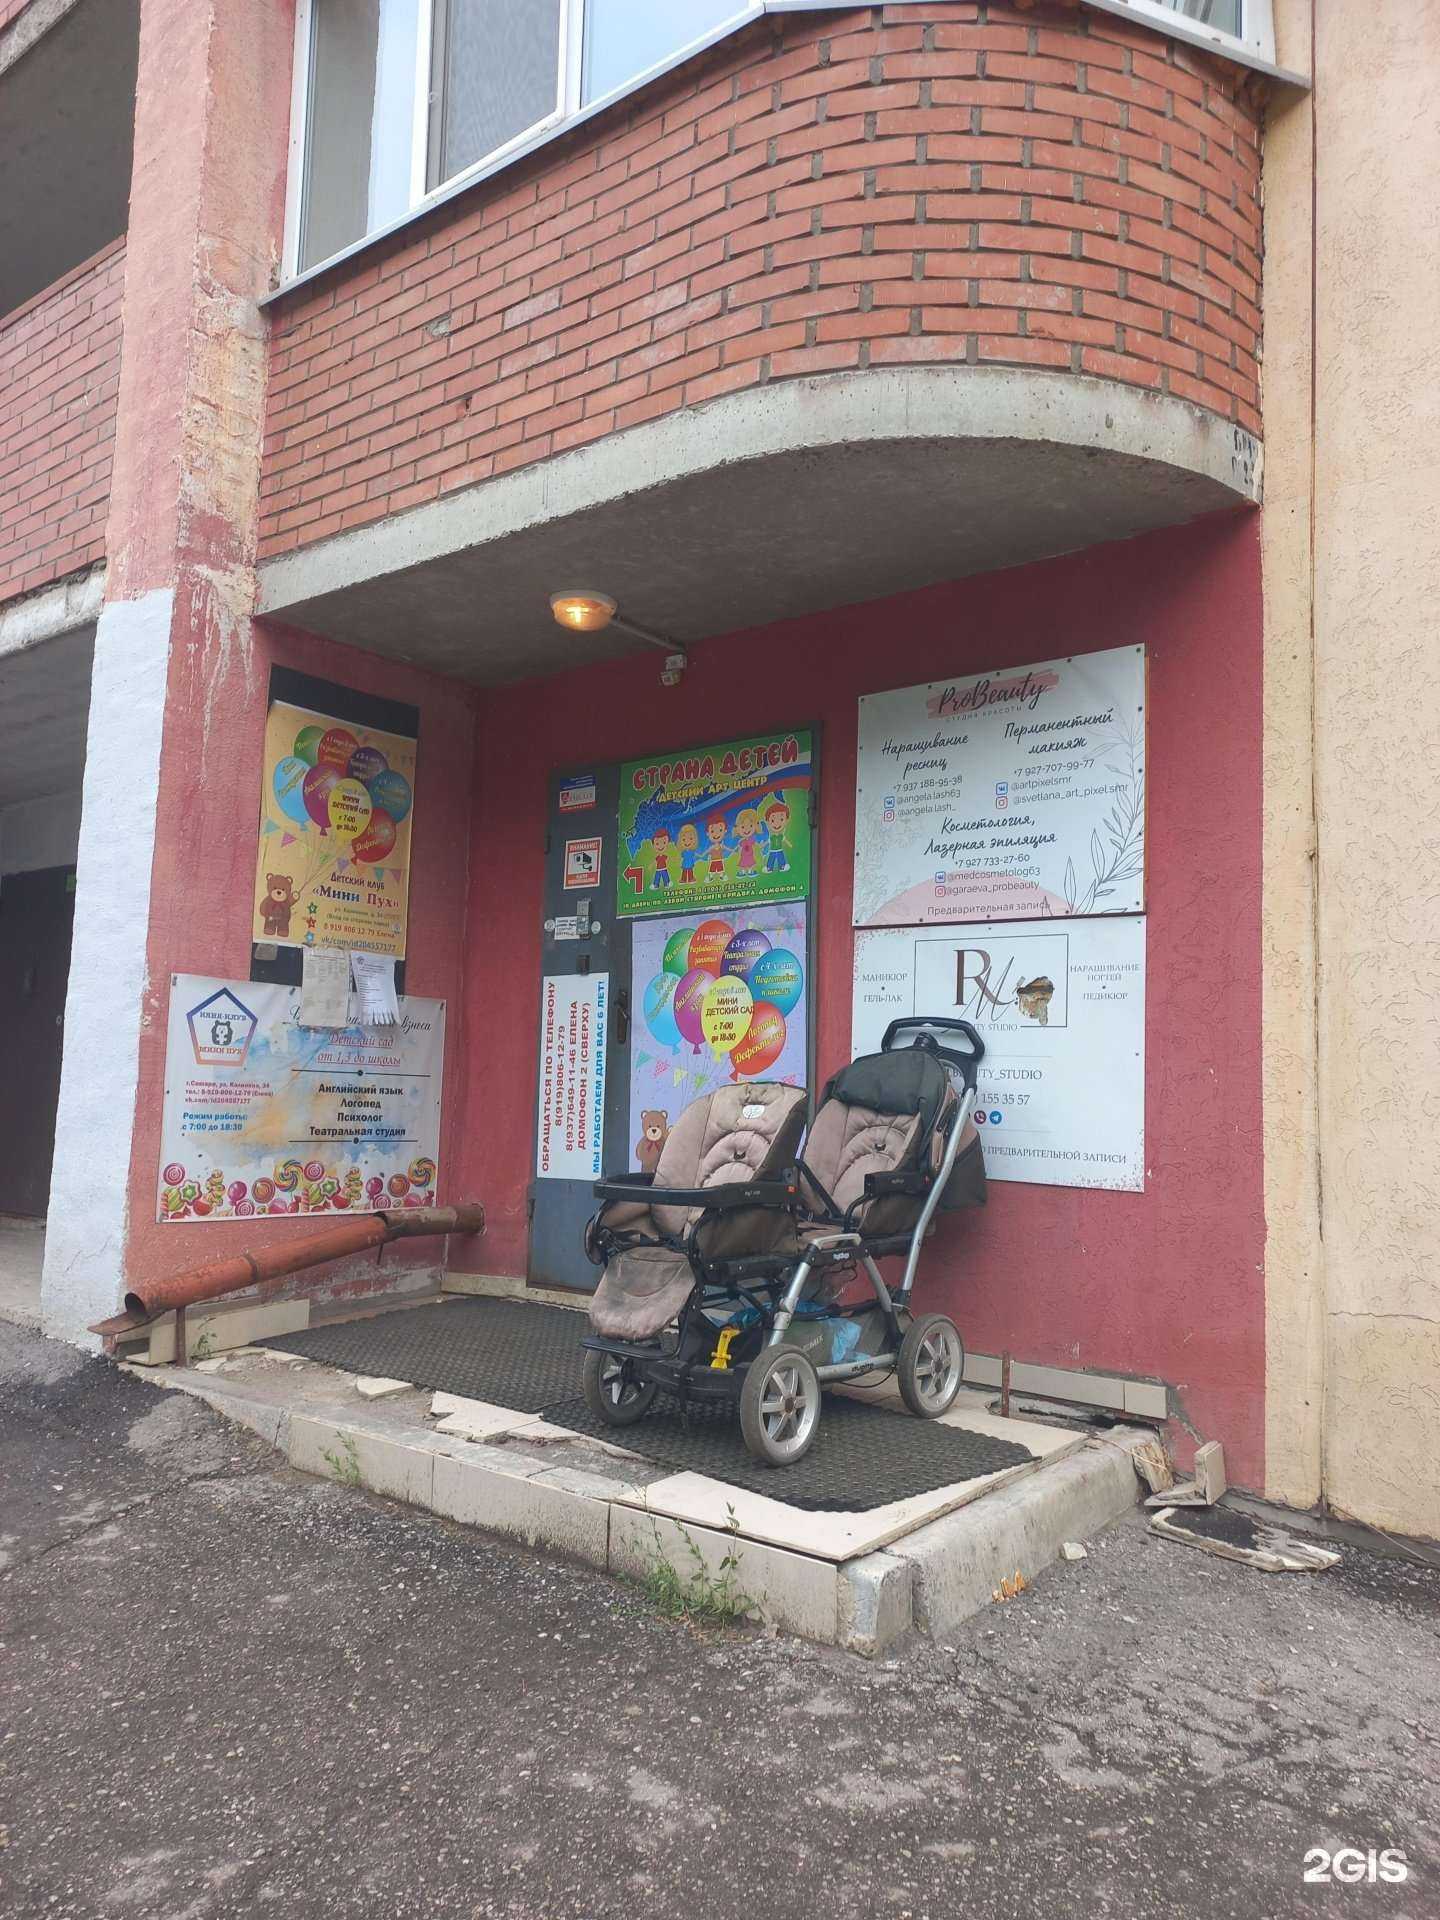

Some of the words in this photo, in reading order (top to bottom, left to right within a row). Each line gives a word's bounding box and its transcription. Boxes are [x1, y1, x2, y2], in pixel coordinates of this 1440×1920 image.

[938, 672, 1049, 713] ProBeauty
[1004, 707, 1114, 744] Перманентный
[881, 732, 969, 761] Наращивание
[1028, 737, 1088, 754] макияж
[632, 755, 715, 791] СТРАНА
[719, 734, 799, 776] ДЕТЕЙ
[903, 758, 947, 780] ресниц
[1025, 759, 1095, 776] 927-707-99-77
[941, 816, 1035, 834] Косметология,
[924, 838, 986, 859] Лазерная
[990, 833, 1058, 849] эпиляция
[984, 854, 1030, 866] 733-27-60
[927, 904, 1014, 916] Предварительная
[862, 973, 908, 982] МАНИКЮР
[597, 980, 605, 1008] ЛЕТ!
[546, 982, 555, 1052] ТЕЛЕФОНУ
[569, 1000, 578, 1045] ЕЛЕНА
[581, 1002, 591, 1063] (СВЕРХУ)
[546, 1056, 553, 1074] ПО
[595, 1051, 604, 1076] ДЛЯ
[555, 1025, 566, 1127] 8(919)806-12-79
[318, 1082, 377, 1095] Английский
[379, 1087, 404, 1096] язык
[983, 1093, 999, 1104] 155
[1002, 1094, 1015, 1105] 35
[1018, 1094, 1031, 1105] 57
[340, 1098, 382, 1109] Логопед
[578, 1078, 587, 1150] ДОМОФОН
[593, 1080, 603, 1148] РАБОТАЕМ
[337, 1112, 384, 1122] Психолог
[542, 1079, 552, 1172] ОБРАЩАТЬСЯ
[309, 1126, 373, 1138] Театральная
[375, 1127, 406, 1138] студия
[592, 1151, 600, 1173] МЫ
[987, 1145, 1081, 1161] ПРЕДВАРИТЕЛЬНОЙ
[1083, 1151, 1127, 1164] ЗАПИСИ
